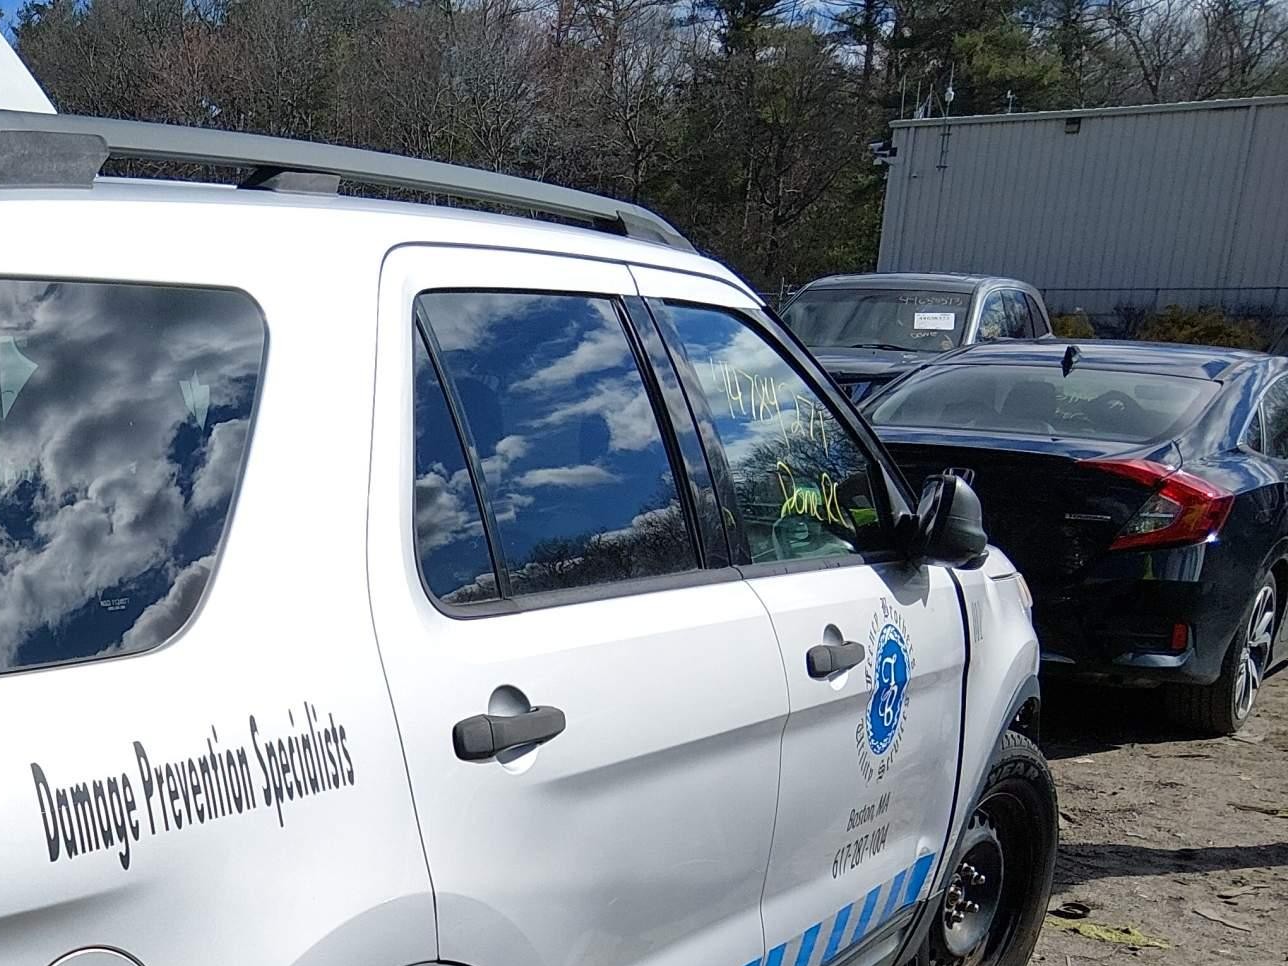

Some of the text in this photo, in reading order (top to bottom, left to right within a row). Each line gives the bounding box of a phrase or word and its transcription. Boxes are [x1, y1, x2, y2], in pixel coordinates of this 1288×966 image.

[31, 701, 355, 870] Damage Prevention Specialists
[875, 791, 891, 817] MA
